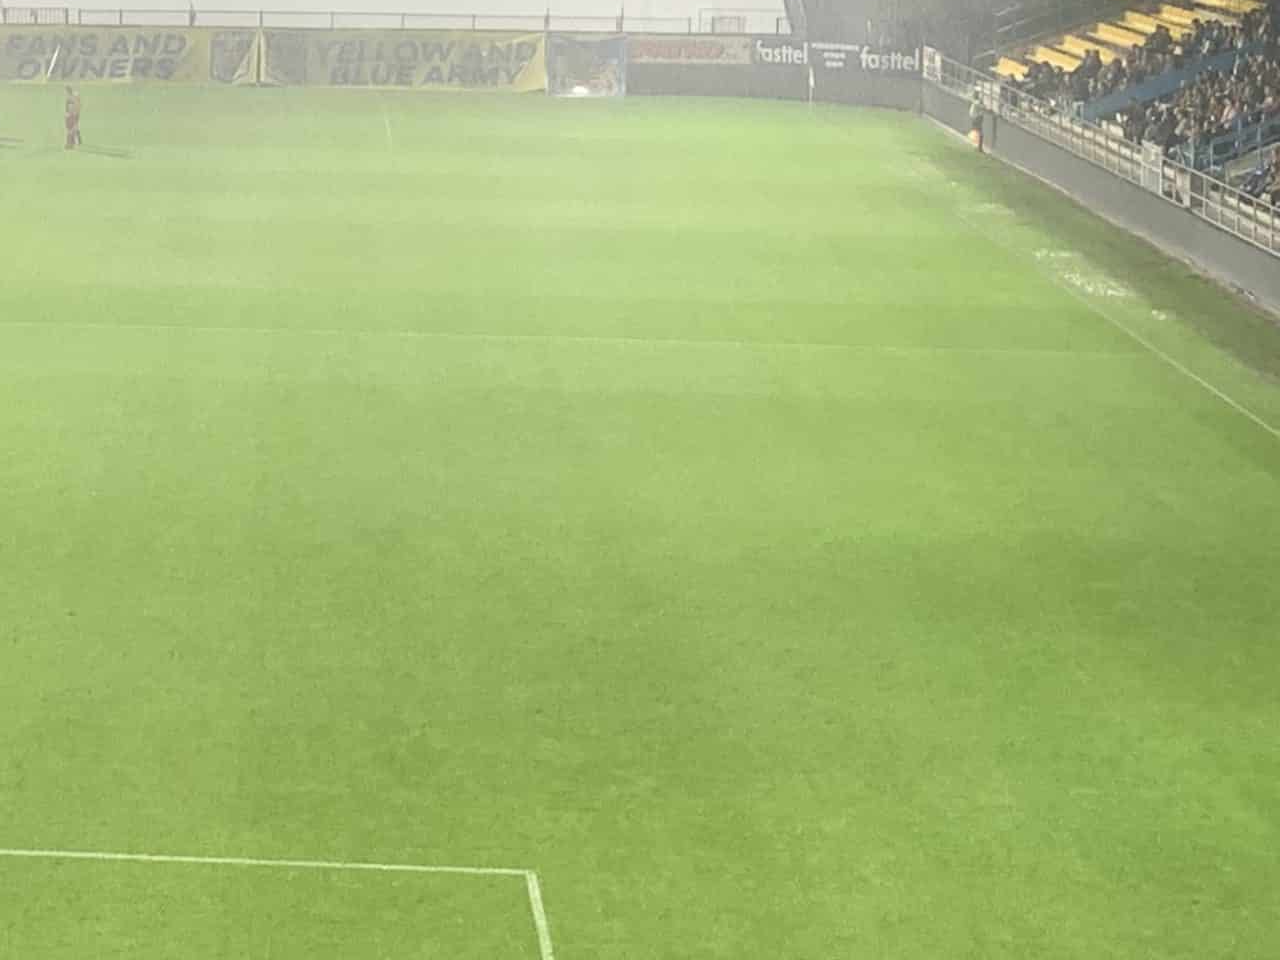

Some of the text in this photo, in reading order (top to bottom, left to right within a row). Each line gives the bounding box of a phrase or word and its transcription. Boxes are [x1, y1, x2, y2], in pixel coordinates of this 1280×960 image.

[111, 34, 187, 54] AND
[756, 40, 808, 64] fasttel
[18, 56, 176, 79] OWNERS
[860, 46, 919, 70] fasttel
[330, 64, 416, 86] BLUE
